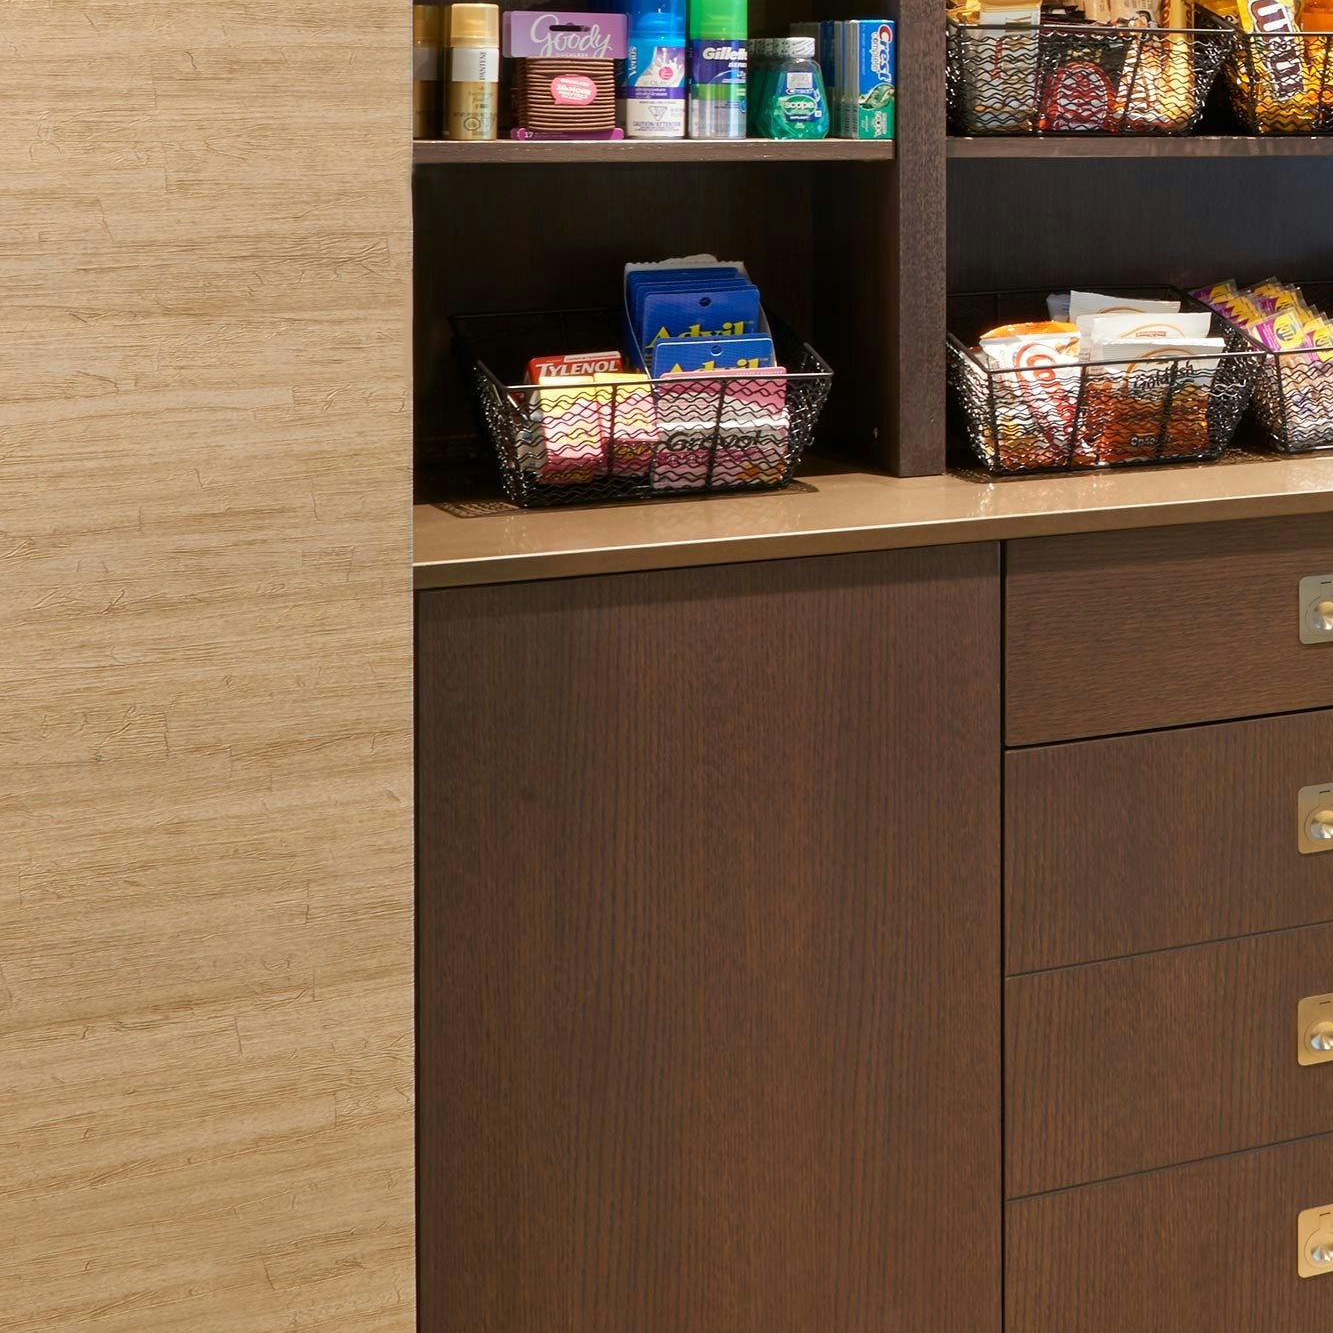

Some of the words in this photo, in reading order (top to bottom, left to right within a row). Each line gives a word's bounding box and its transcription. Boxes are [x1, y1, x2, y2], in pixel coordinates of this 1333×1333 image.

[530, 14, 613, 58] Goody
[783, 100, 815, 112] scope
[535, 360, 619, 378] TYLENOL
